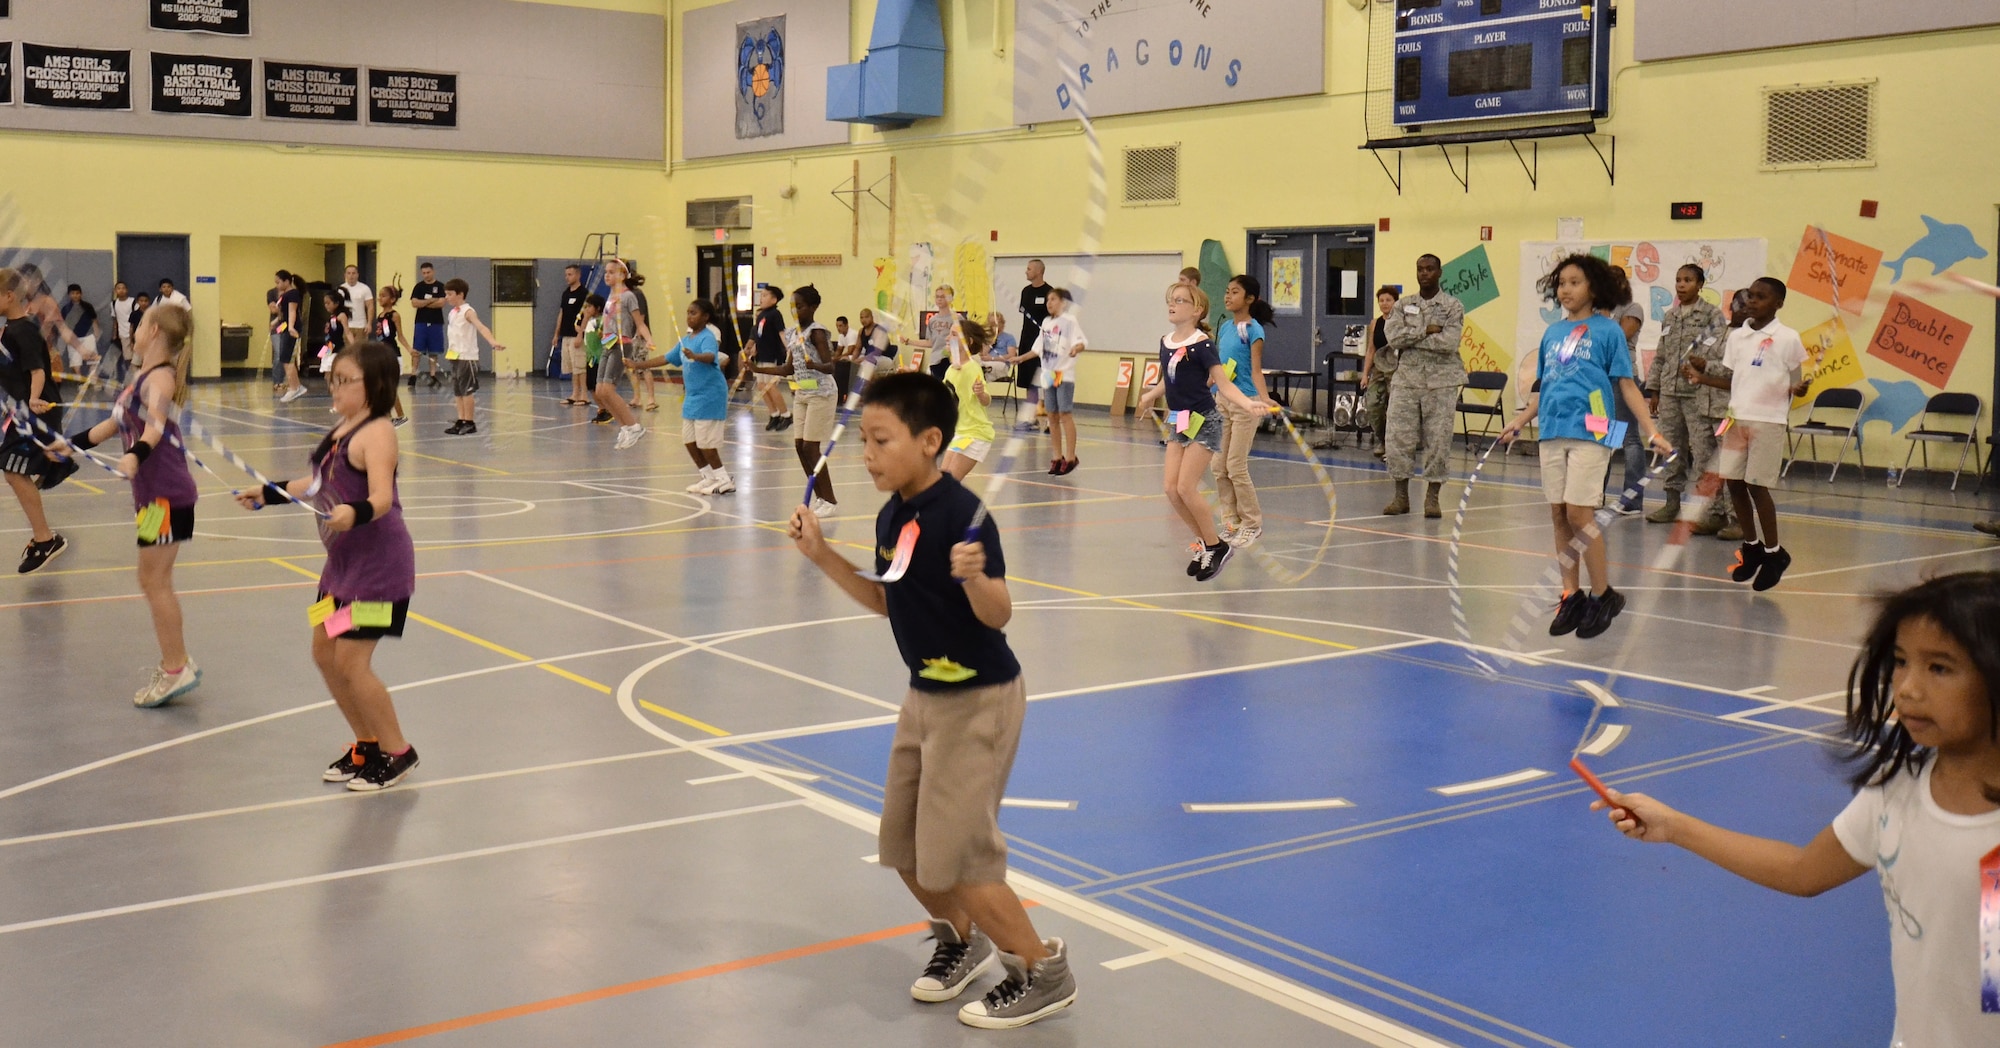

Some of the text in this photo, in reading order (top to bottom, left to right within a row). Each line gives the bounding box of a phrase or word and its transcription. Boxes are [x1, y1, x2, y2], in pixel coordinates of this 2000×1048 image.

[161, 3, 173, 12] MS
[195, 5, 238, 19] CHAMPIONS
[178, 13, 222, 24] 2005-2006
[1075, 20, 1089, 38] TO
[1090, 0, 1112, 21] THE
[1410, 13, 1444, 26] BONUS
[1562, 20, 1591, 34] FOULS
[1474, 31, 1507, 44] PLAYER
[1397, 42, 1422, 54] FOULS
[44, 55, 111, 71] AMS GIRLS
[171, 63, 233, 79] AMS GIRLS
[26, 66, 127, 84] CROSS COUNTRY
[281, 68, 341, 84] AMS GIRLS
[1056, 39, 1242, 110] DRAGONS
[35, 79, 47, 89] MS
[72, 81, 119, 93] CHAMPIONS
[163, 75, 240, 92] BASKETBALL
[266, 79, 356, 97] CROSS COUNTRY
[387, 76, 439, 90] AMS BOYS
[163, 87, 175, 97] MS
[197, 88, 241, 101] CHAMPIONS
[274, 92, 285, 102] MS
[307, 94, 351, 106] CHAMPIONS
[371, 86, 455, 104] CROSS COUNTRY
[1567, 89, 1587, 101] WON
[289, 104, 335, 114] 2005-2006
[377, 99, 388, 108] MS
[409, 101, 449, 112] CHAMPIONS
[1399, 104, 1416, 116] WON
[1474, 97, 1502, 109] GAME
[1803, 239, 1869, 275] Altrnate
[1807, 261, 1847, 288] Sped
[1892, 302, 1954, 346] Double
[1875, 324, 1948, 375] Bounce
[911, 354, 922, 370] 5
[1804, 355, 1851, 385] ounce
[1117, 363, 1132, 386] 3
[1144, 364, 1159, 387] 2
